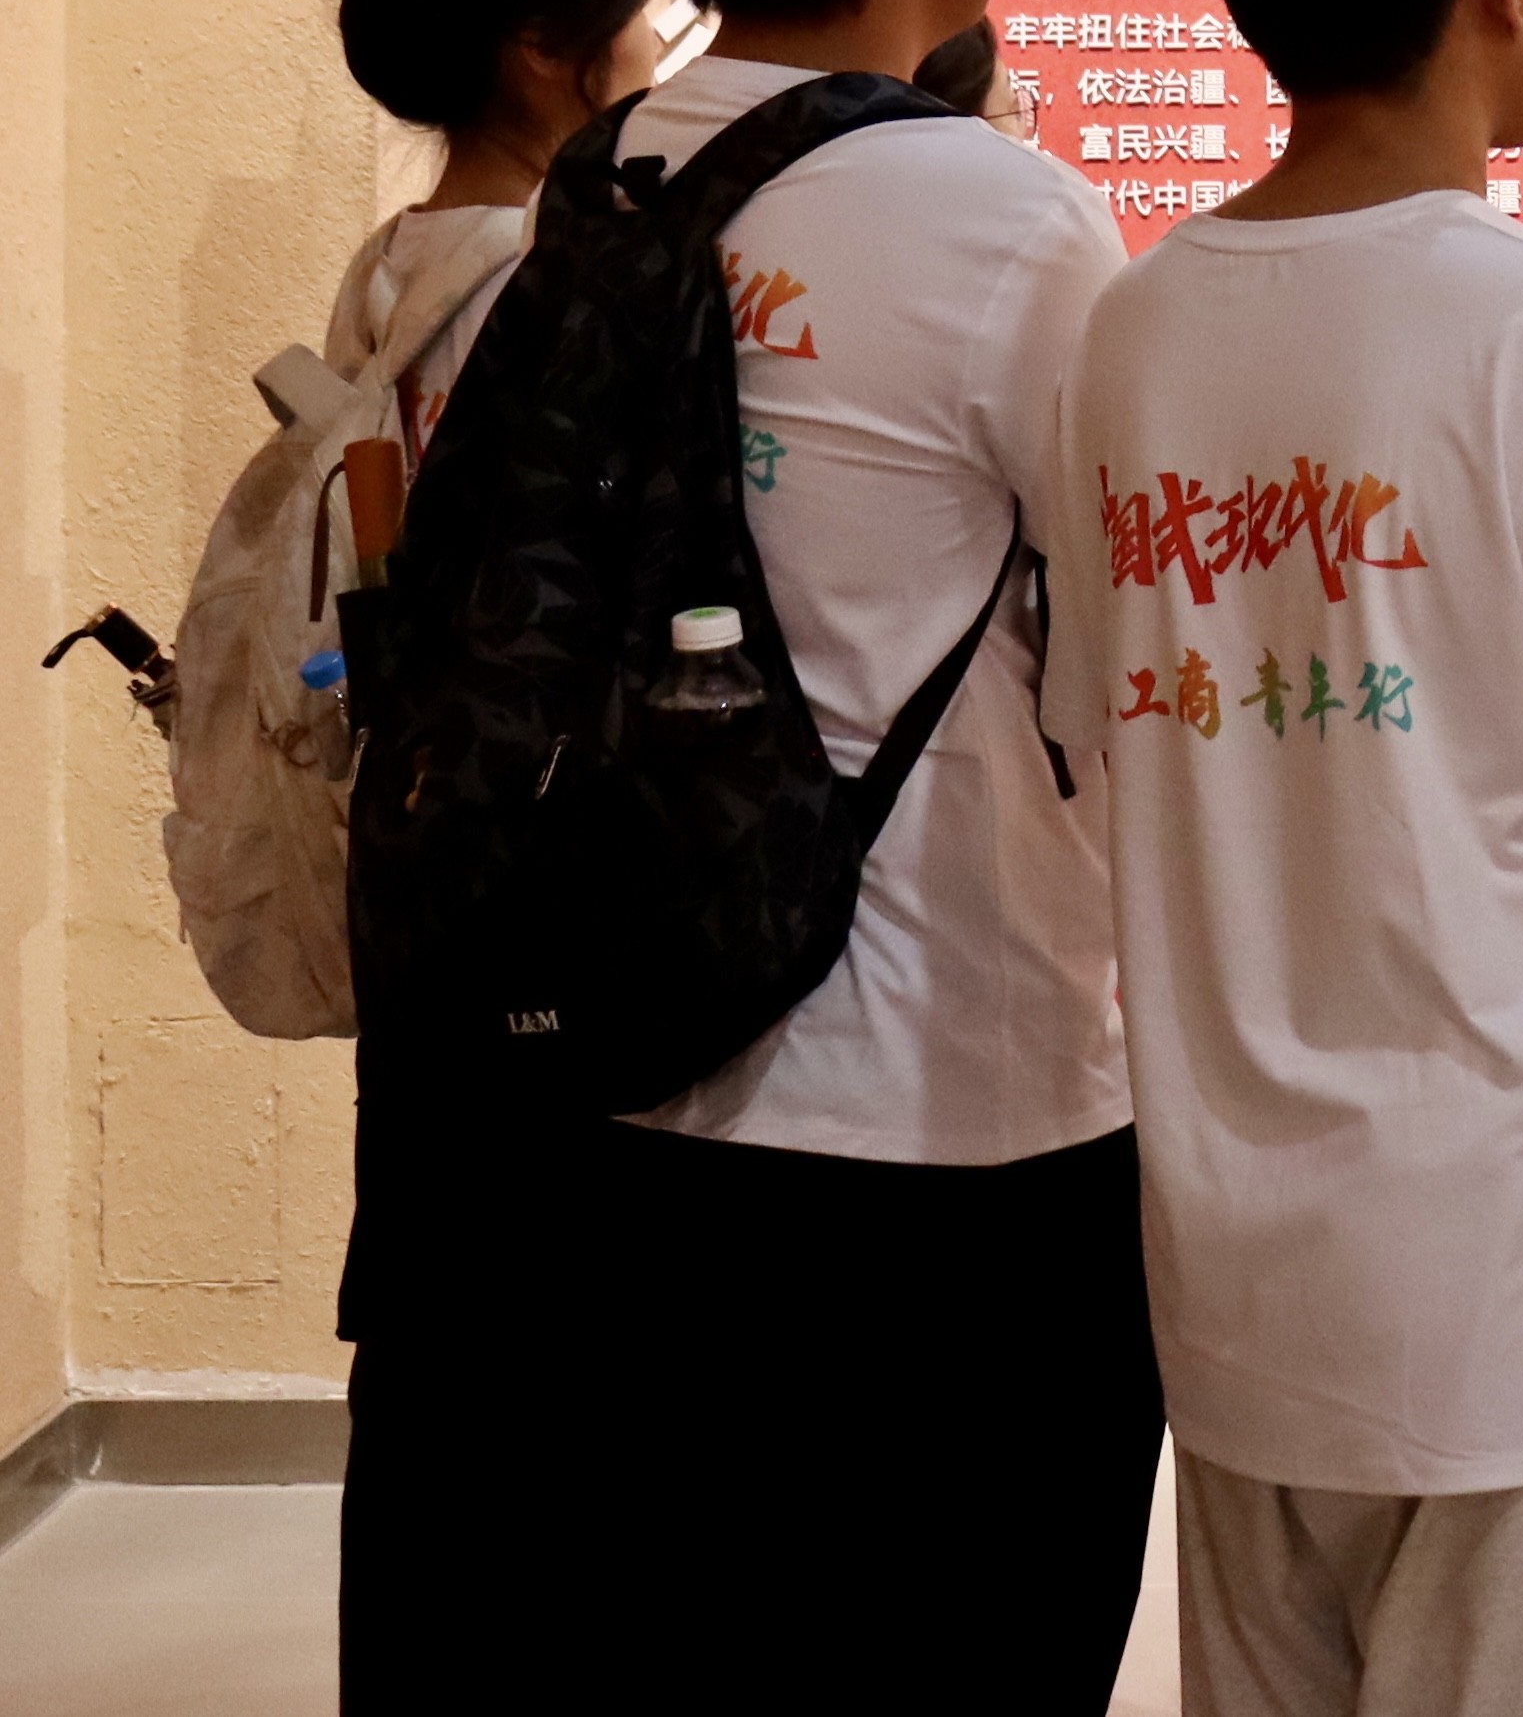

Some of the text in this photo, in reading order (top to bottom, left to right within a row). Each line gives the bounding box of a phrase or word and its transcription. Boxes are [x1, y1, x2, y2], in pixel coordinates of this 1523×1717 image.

[1100, 455, 1428, 605] 国式现代化
[1105, 645, 1415, 744] 工商青年行
